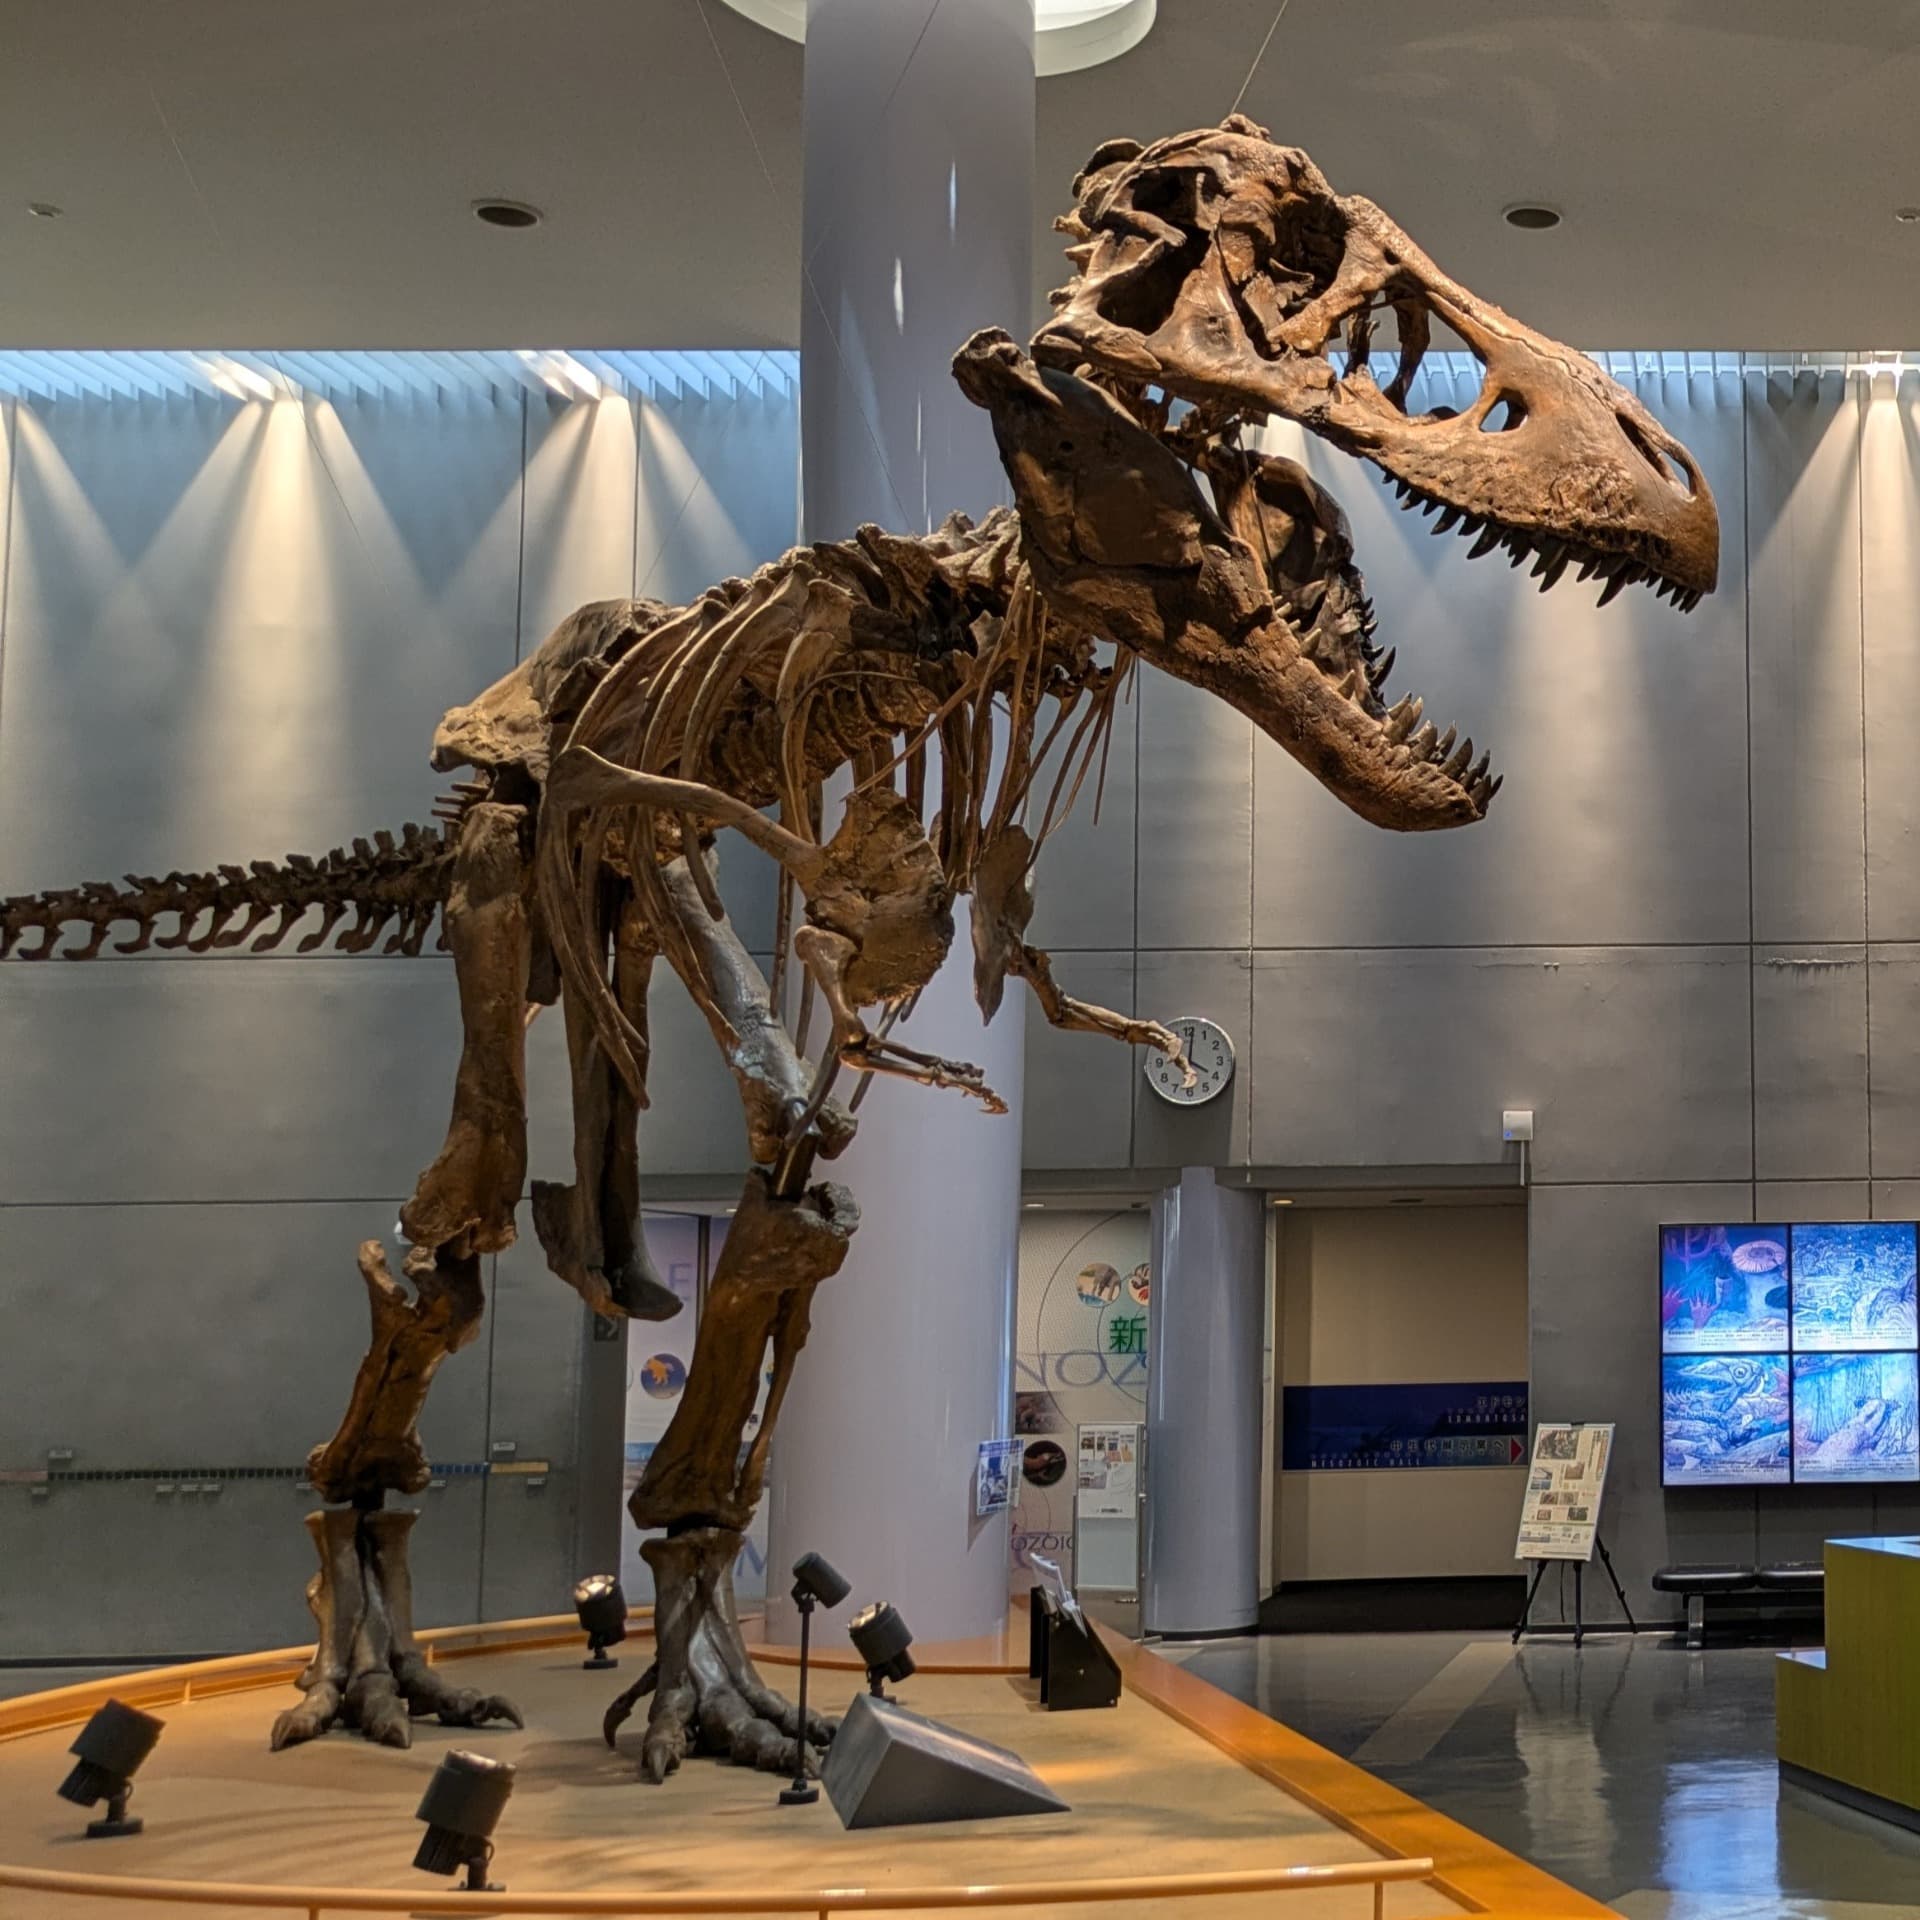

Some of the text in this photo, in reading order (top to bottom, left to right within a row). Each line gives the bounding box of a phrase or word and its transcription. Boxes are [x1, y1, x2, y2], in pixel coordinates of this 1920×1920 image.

[1184, 1027, 1195, 1037] 12
[1202, 1031, 1207, 1040] 1
[1212, 1040, 1220, 1050] 2
[1156, 1058, 1163, 1068] 9
[1216, 1056, 1223, 1066] 3
[1160, 1073, 1168, 1083] 8
[1212, 1072, 1219, 1081] 4
[1171, 1084, 1179, 1094] 7
[1202, 1082, 1210, 1092] 5
[1186, 1088, 1193, 1097] 6
[1110, 1316, 1147, 1353] 新
